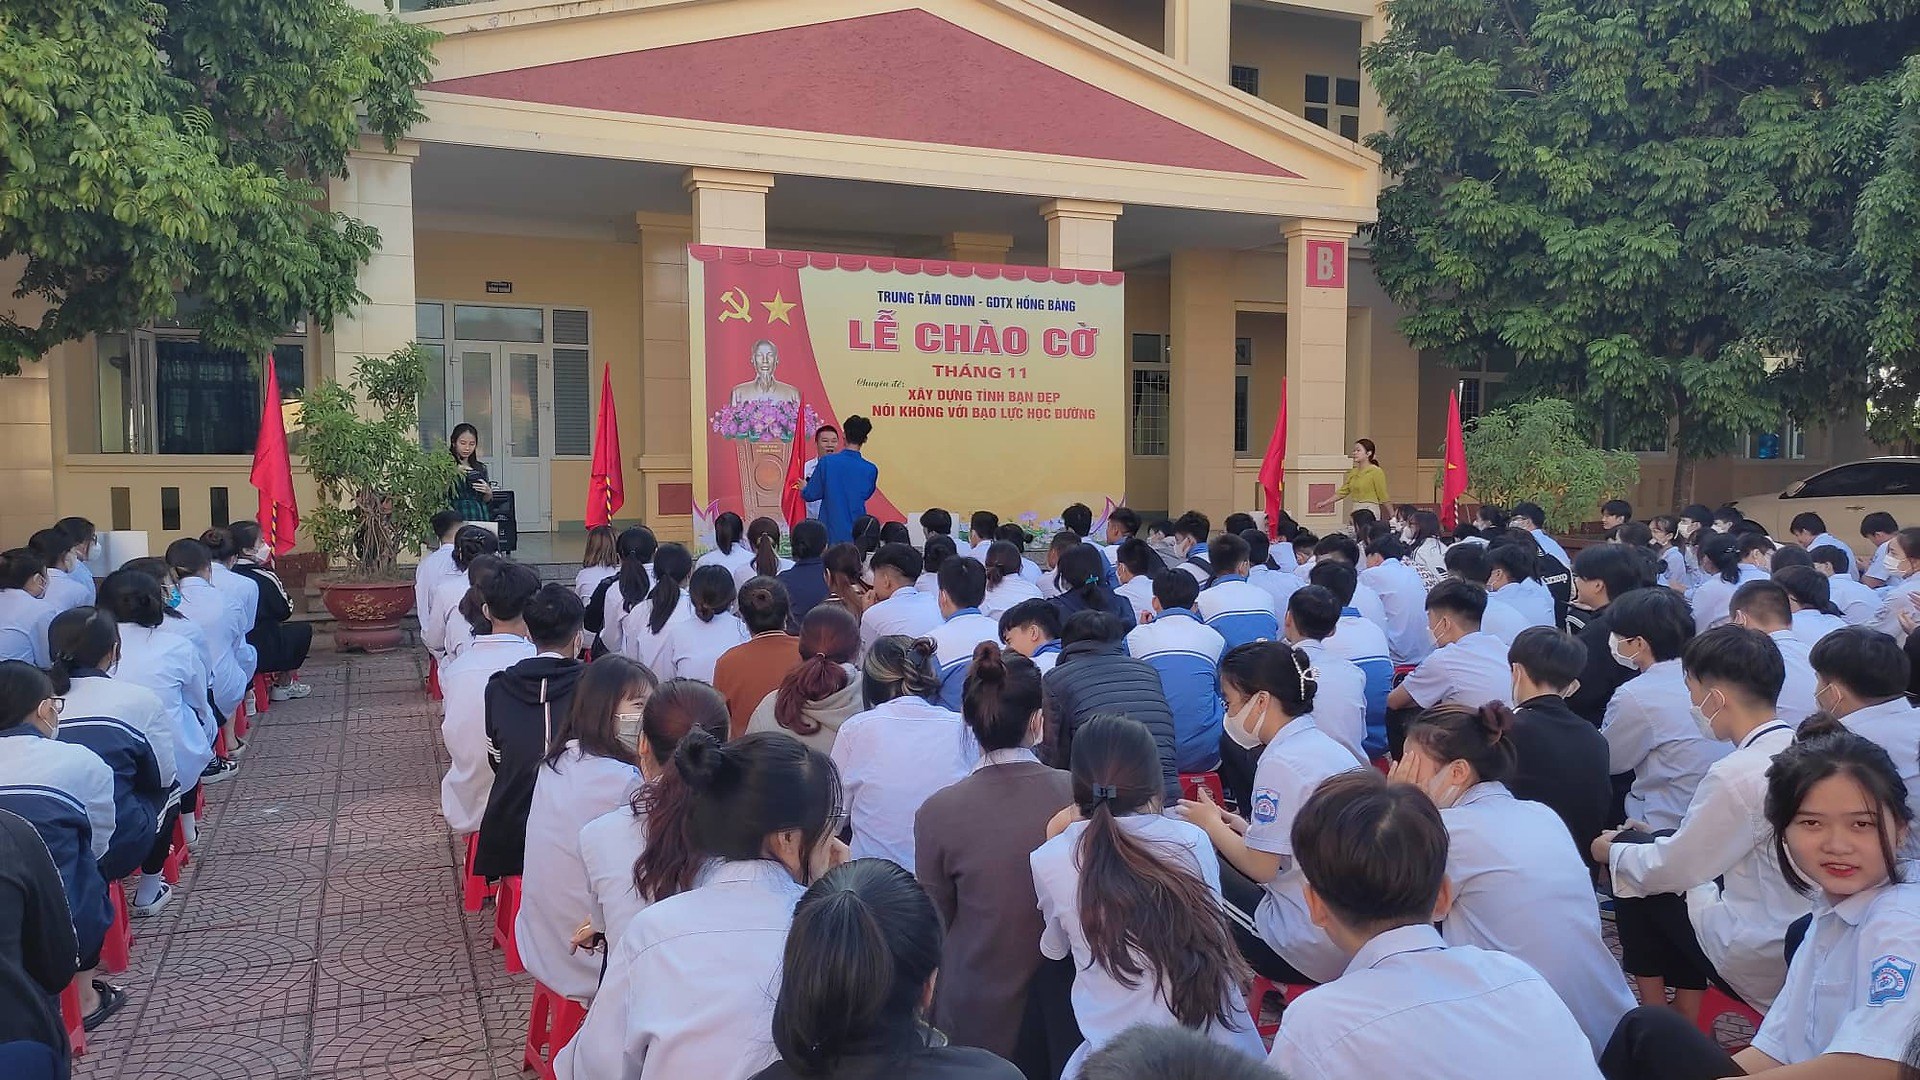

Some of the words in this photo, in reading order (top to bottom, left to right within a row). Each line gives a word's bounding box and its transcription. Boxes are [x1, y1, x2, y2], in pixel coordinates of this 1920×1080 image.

[1317, 246, 1334, 280] B
[877, 290, 915, 304] TRUNG
[918, 290, 942, 305] TÂM
[945, 294, 975, 307] GDNN
[986, 296, 1013, 309] GDTX
[1048, 297, 1076, 312] BÀNG
[848, 309, 900, 352] LỄ
[914, 319, 1029, 356] CHÀO
[1042, 321, 1100, 359] CỜ
[932, 363, 1002, 379] THÁNG
[1008, 367, 1027, 379] 11
[908, 387, 933, 401] XÂY
[937, 389, 972, 403] DỰNG
[976, 388, 1005, 402] TÌNH
[1008, 391, 1033, 404] BẠN
[1037, 392, 1061, 405] ĐẸP
[872, 403, 895, 417] NÓI
[899, 404, 944, 418] KHÔNG
[948, 404, 968, 418] VỚI
[972, 407, 997, 421] BẠO
[1000, 407, 1024, 421] LỰC
[1027, 407, 1051, 421] HỌC
[1054, 407, 1096, 420] ĐƯỜNG
